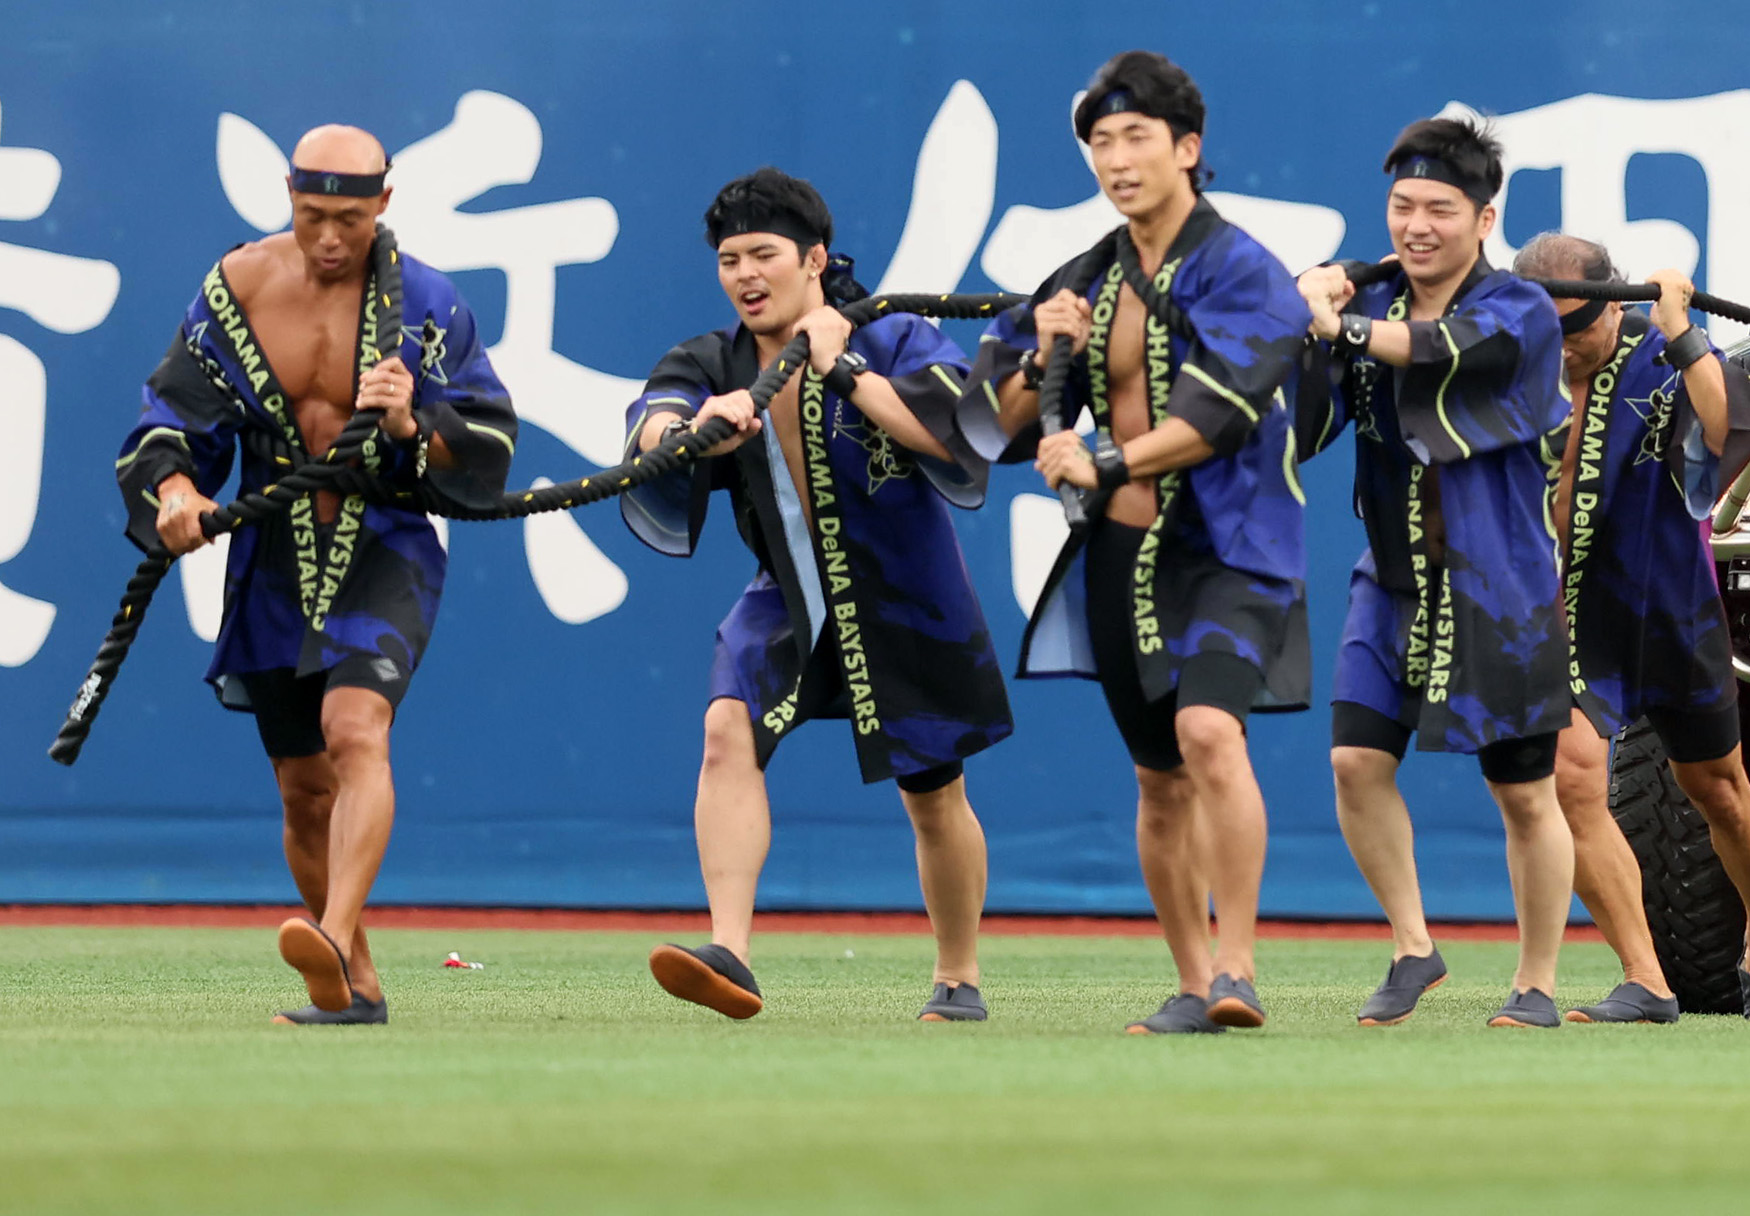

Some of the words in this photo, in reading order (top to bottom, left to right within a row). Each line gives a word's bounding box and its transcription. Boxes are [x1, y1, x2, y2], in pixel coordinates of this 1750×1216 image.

[818, 516, 852, 596] DeNA
[1570, 493, 1598, 567] DeNA
[833, 601, 881, 736] BAYSTARS
